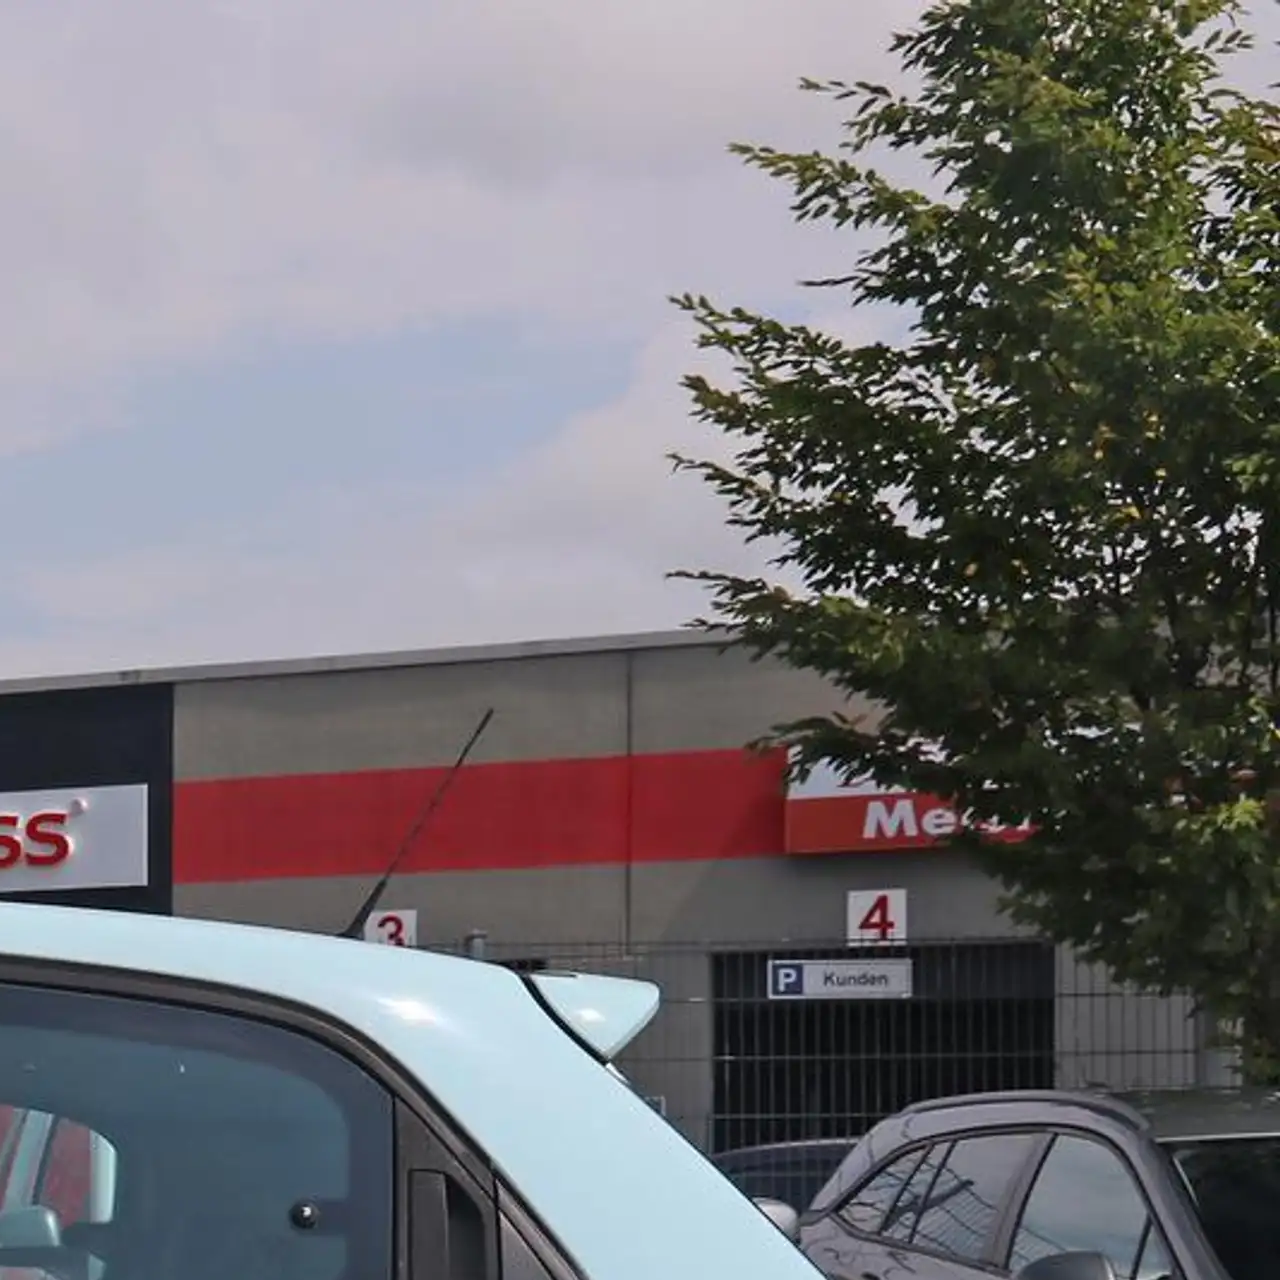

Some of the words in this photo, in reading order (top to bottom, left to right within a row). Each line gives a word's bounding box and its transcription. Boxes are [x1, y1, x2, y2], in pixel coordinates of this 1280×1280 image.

[858, 893, 895, 942] 4
[777, 967, 797, 993] P
[822, 971, 889, 988] Kunden
